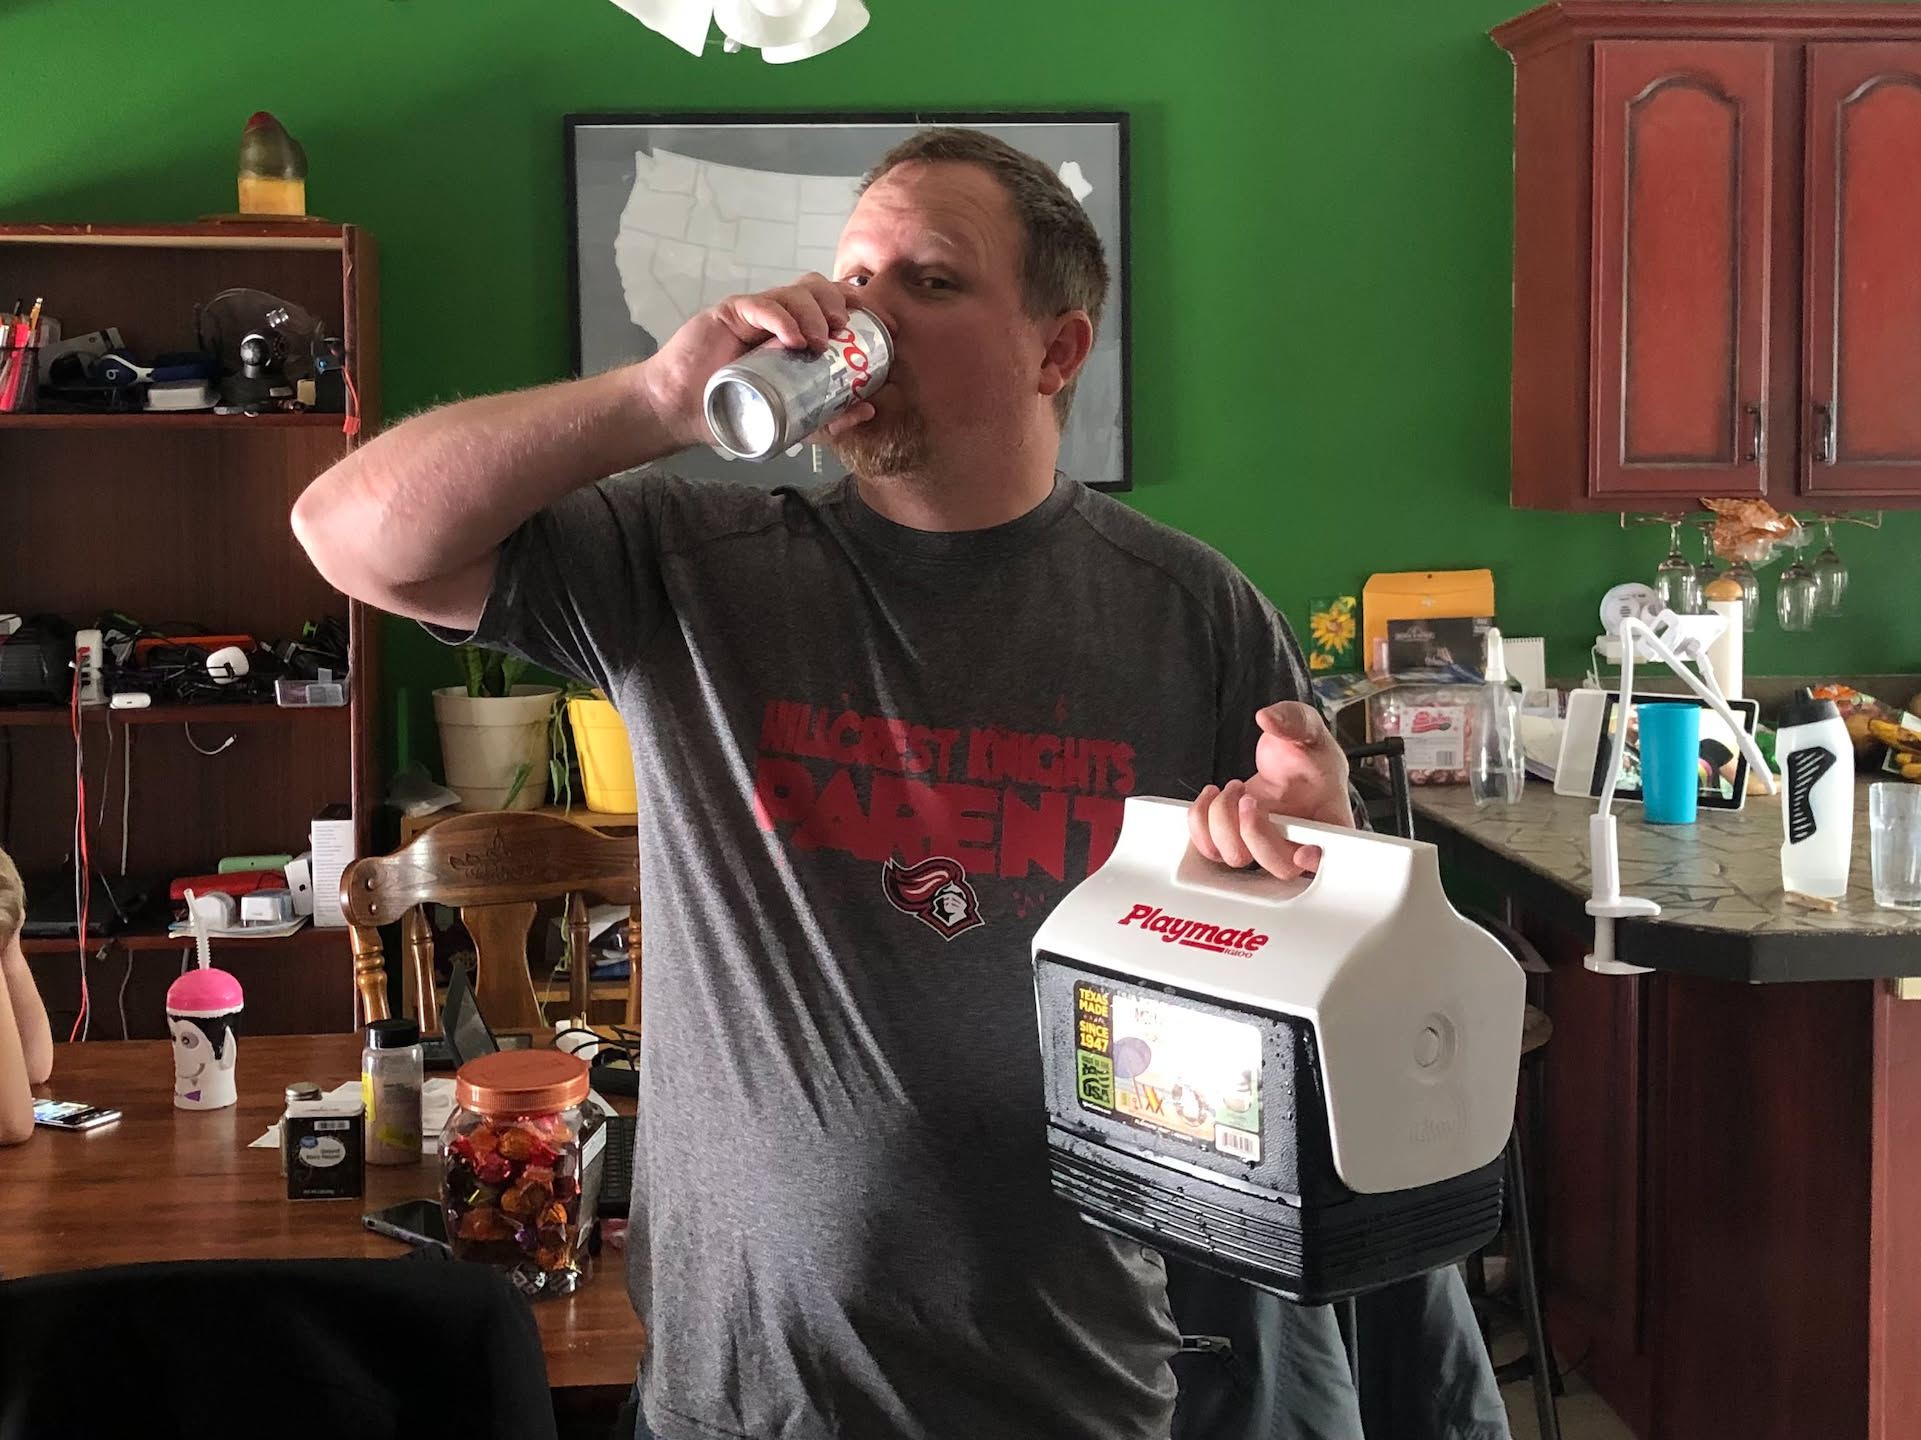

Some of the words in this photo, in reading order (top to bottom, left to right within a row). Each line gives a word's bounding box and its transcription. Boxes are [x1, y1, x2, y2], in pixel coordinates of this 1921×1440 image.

[759, 699, 960, 775] HILLCREST
[968, 725, 1137, 795] KNIGHTS
[753, 757, 1127, 883] PARENT
[1118, 903, 1270, 952] Playmate
[1078, 988, 1109, 1006] TEXAS
[1078, 999, 1109, 1018] MADE
[1079, 1020, 1109, 1040] SINCE
[1080, 1033, 1110, 1053] 1947
[1083, 1081, 1111, 1105] USA
